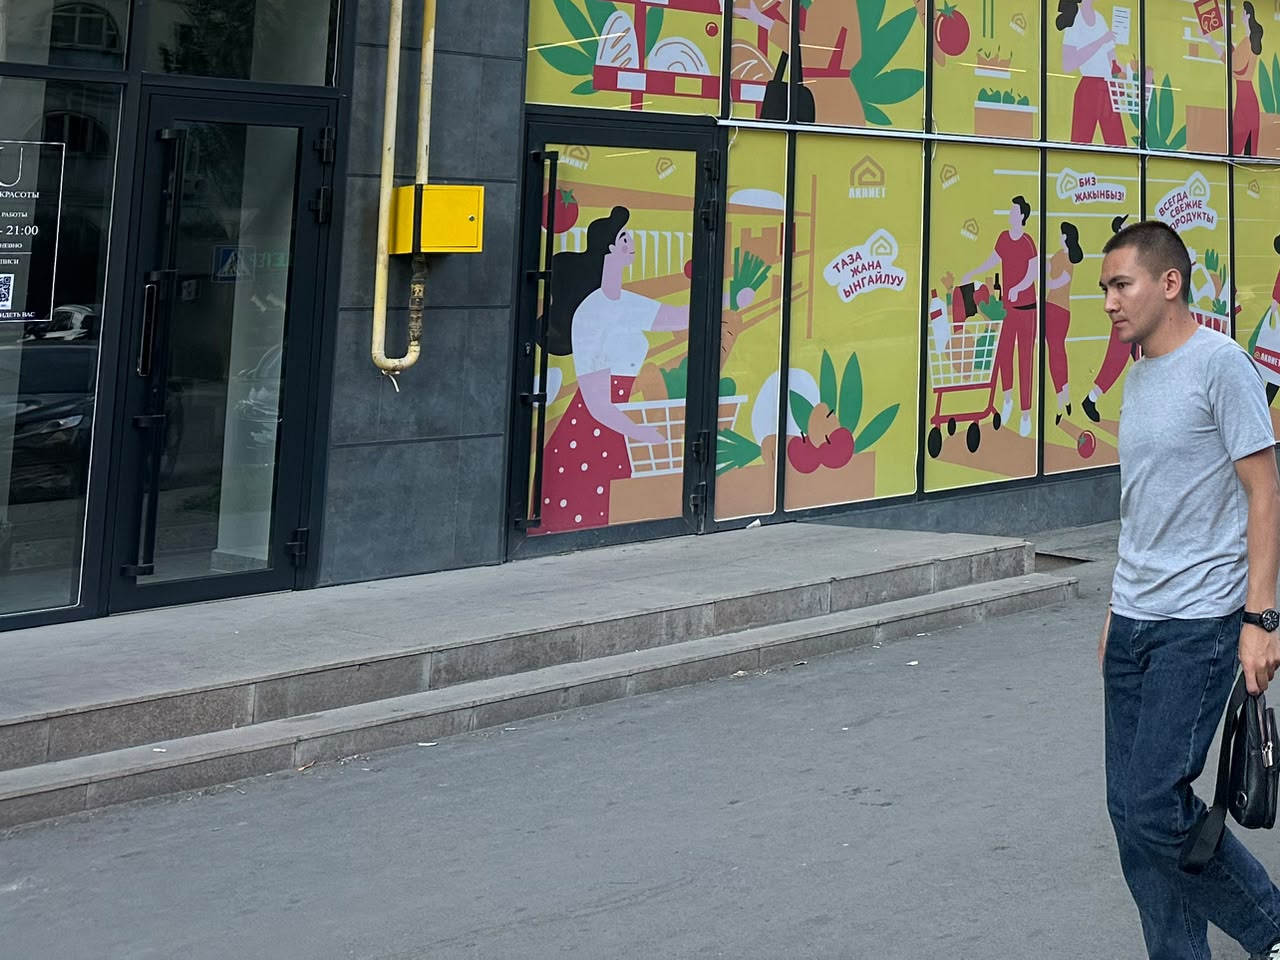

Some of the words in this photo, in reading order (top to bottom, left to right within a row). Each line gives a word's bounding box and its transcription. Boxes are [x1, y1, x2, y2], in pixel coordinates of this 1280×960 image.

[1078, 176, 1097, 188] БИЗ
[0, 191, 40, 199] КРАСОТЫ
[1074, 190, 1125, 203] ЖАКЫНБЫЗ!
[1158, 190, 1189, 217] ВСЕГДА
[1169, 199, 1203, 219] СВЕЖИЕ
[6, 225, 39, 236] 21:00
[832, 251, 863, 274] ТАЗА
[849, 259, 882, 278] ЖАНА
[843, 271, 904, 299] ЫНГАЙЛУУ
